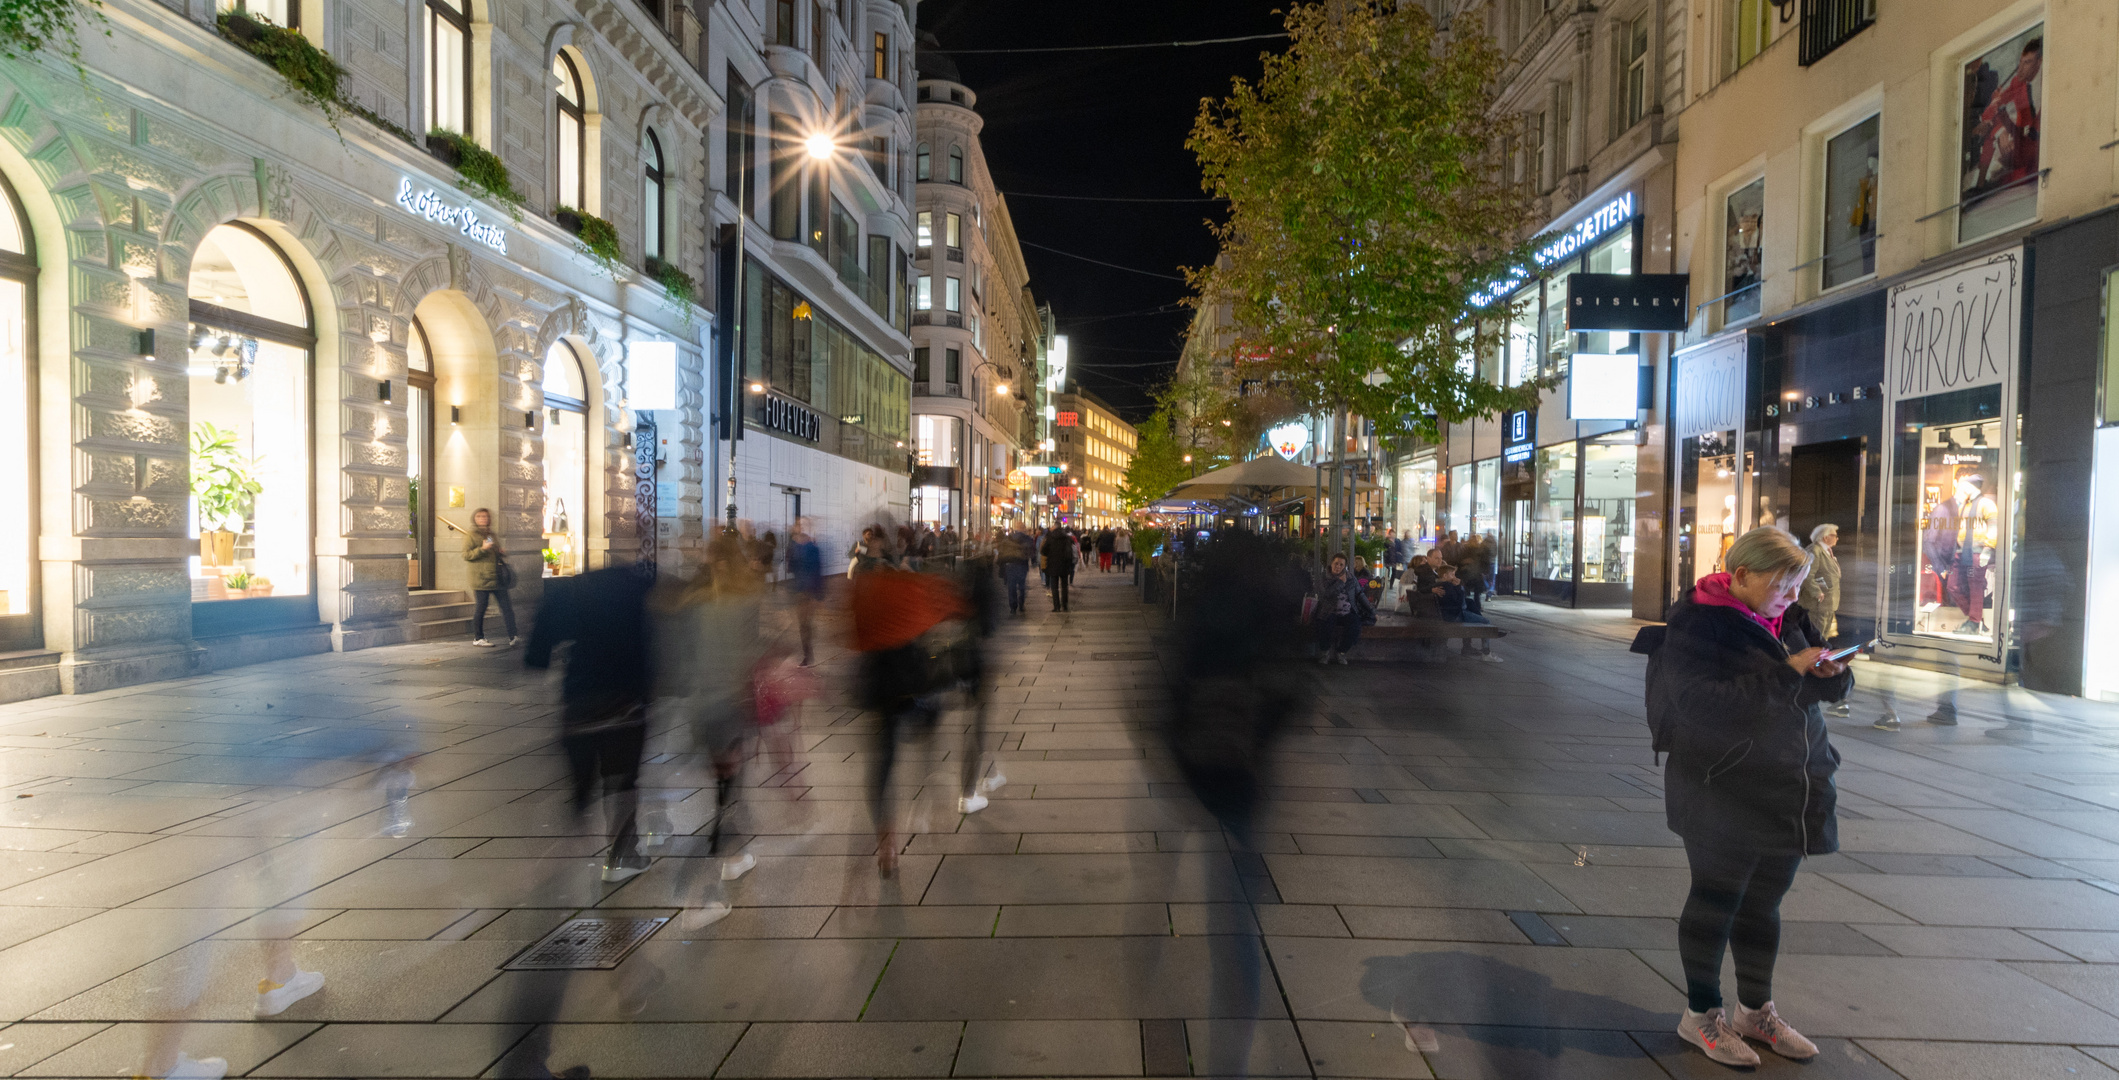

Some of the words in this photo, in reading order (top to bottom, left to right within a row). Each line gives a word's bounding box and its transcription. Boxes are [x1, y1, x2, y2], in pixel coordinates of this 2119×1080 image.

[398, 177, 417, 214] &
[1575, 296, 1681, 307] SISLEY
[1900, 288, 2003, 396] BAROCK
[766, 393, 811, 440] FOREVER
